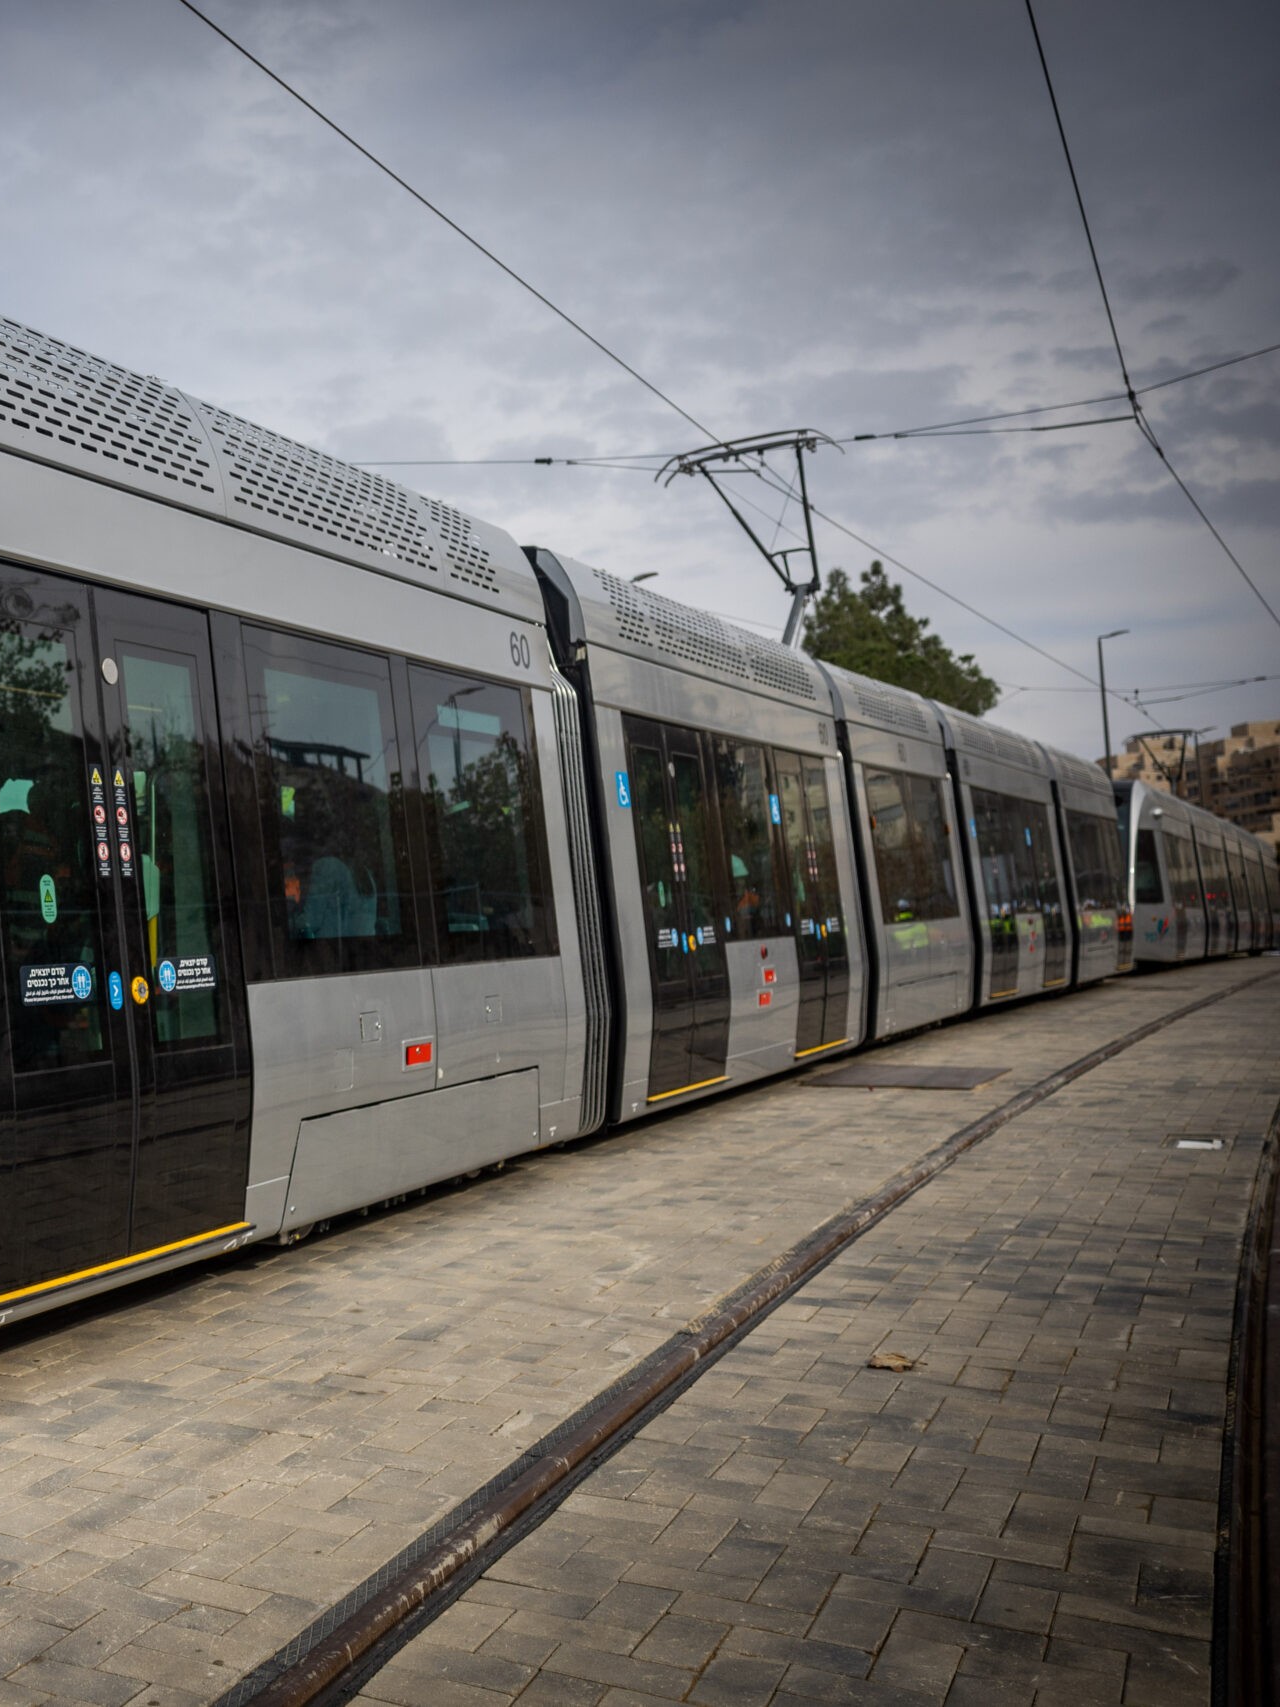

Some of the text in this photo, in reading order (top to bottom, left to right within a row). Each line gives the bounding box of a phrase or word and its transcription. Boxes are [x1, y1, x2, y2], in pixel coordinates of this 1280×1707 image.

[510, 631, 530, 669] 60
[51, 967, 65, 976] קודם
[48, 979, 56, 988] כך
